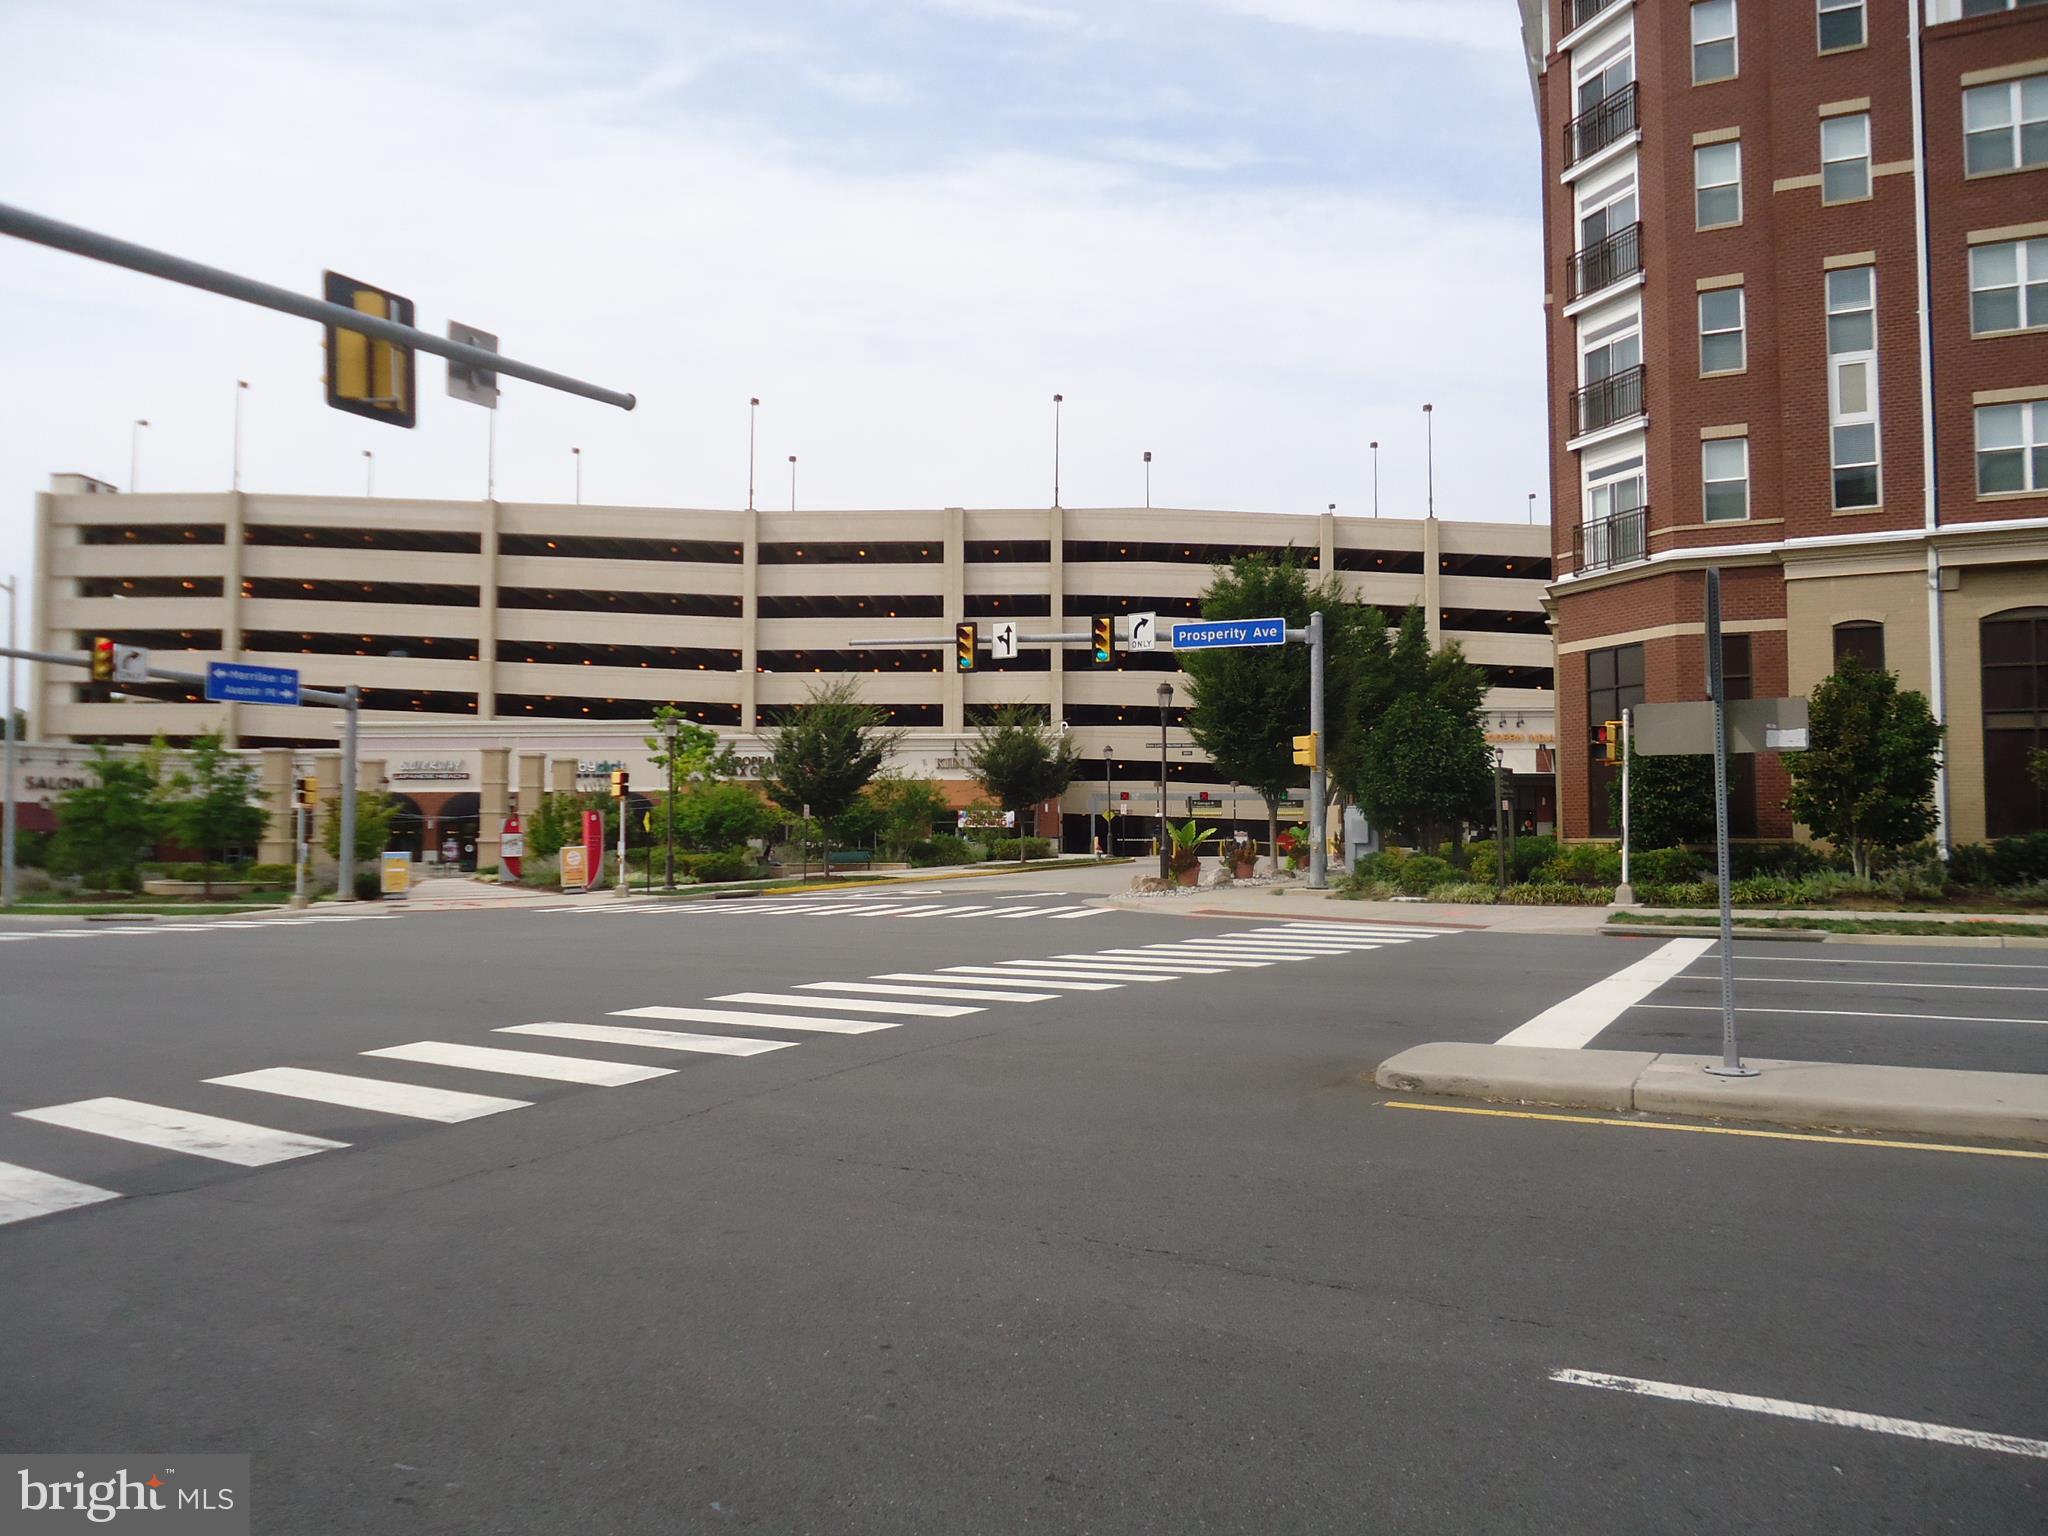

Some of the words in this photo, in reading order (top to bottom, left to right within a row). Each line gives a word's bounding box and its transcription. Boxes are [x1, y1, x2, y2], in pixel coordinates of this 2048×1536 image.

[1179, 628, 1246, 643] Prosperity
[1253, 626, 1277, 638] Ave
[1131, 639, 1152, 649] ONLY
